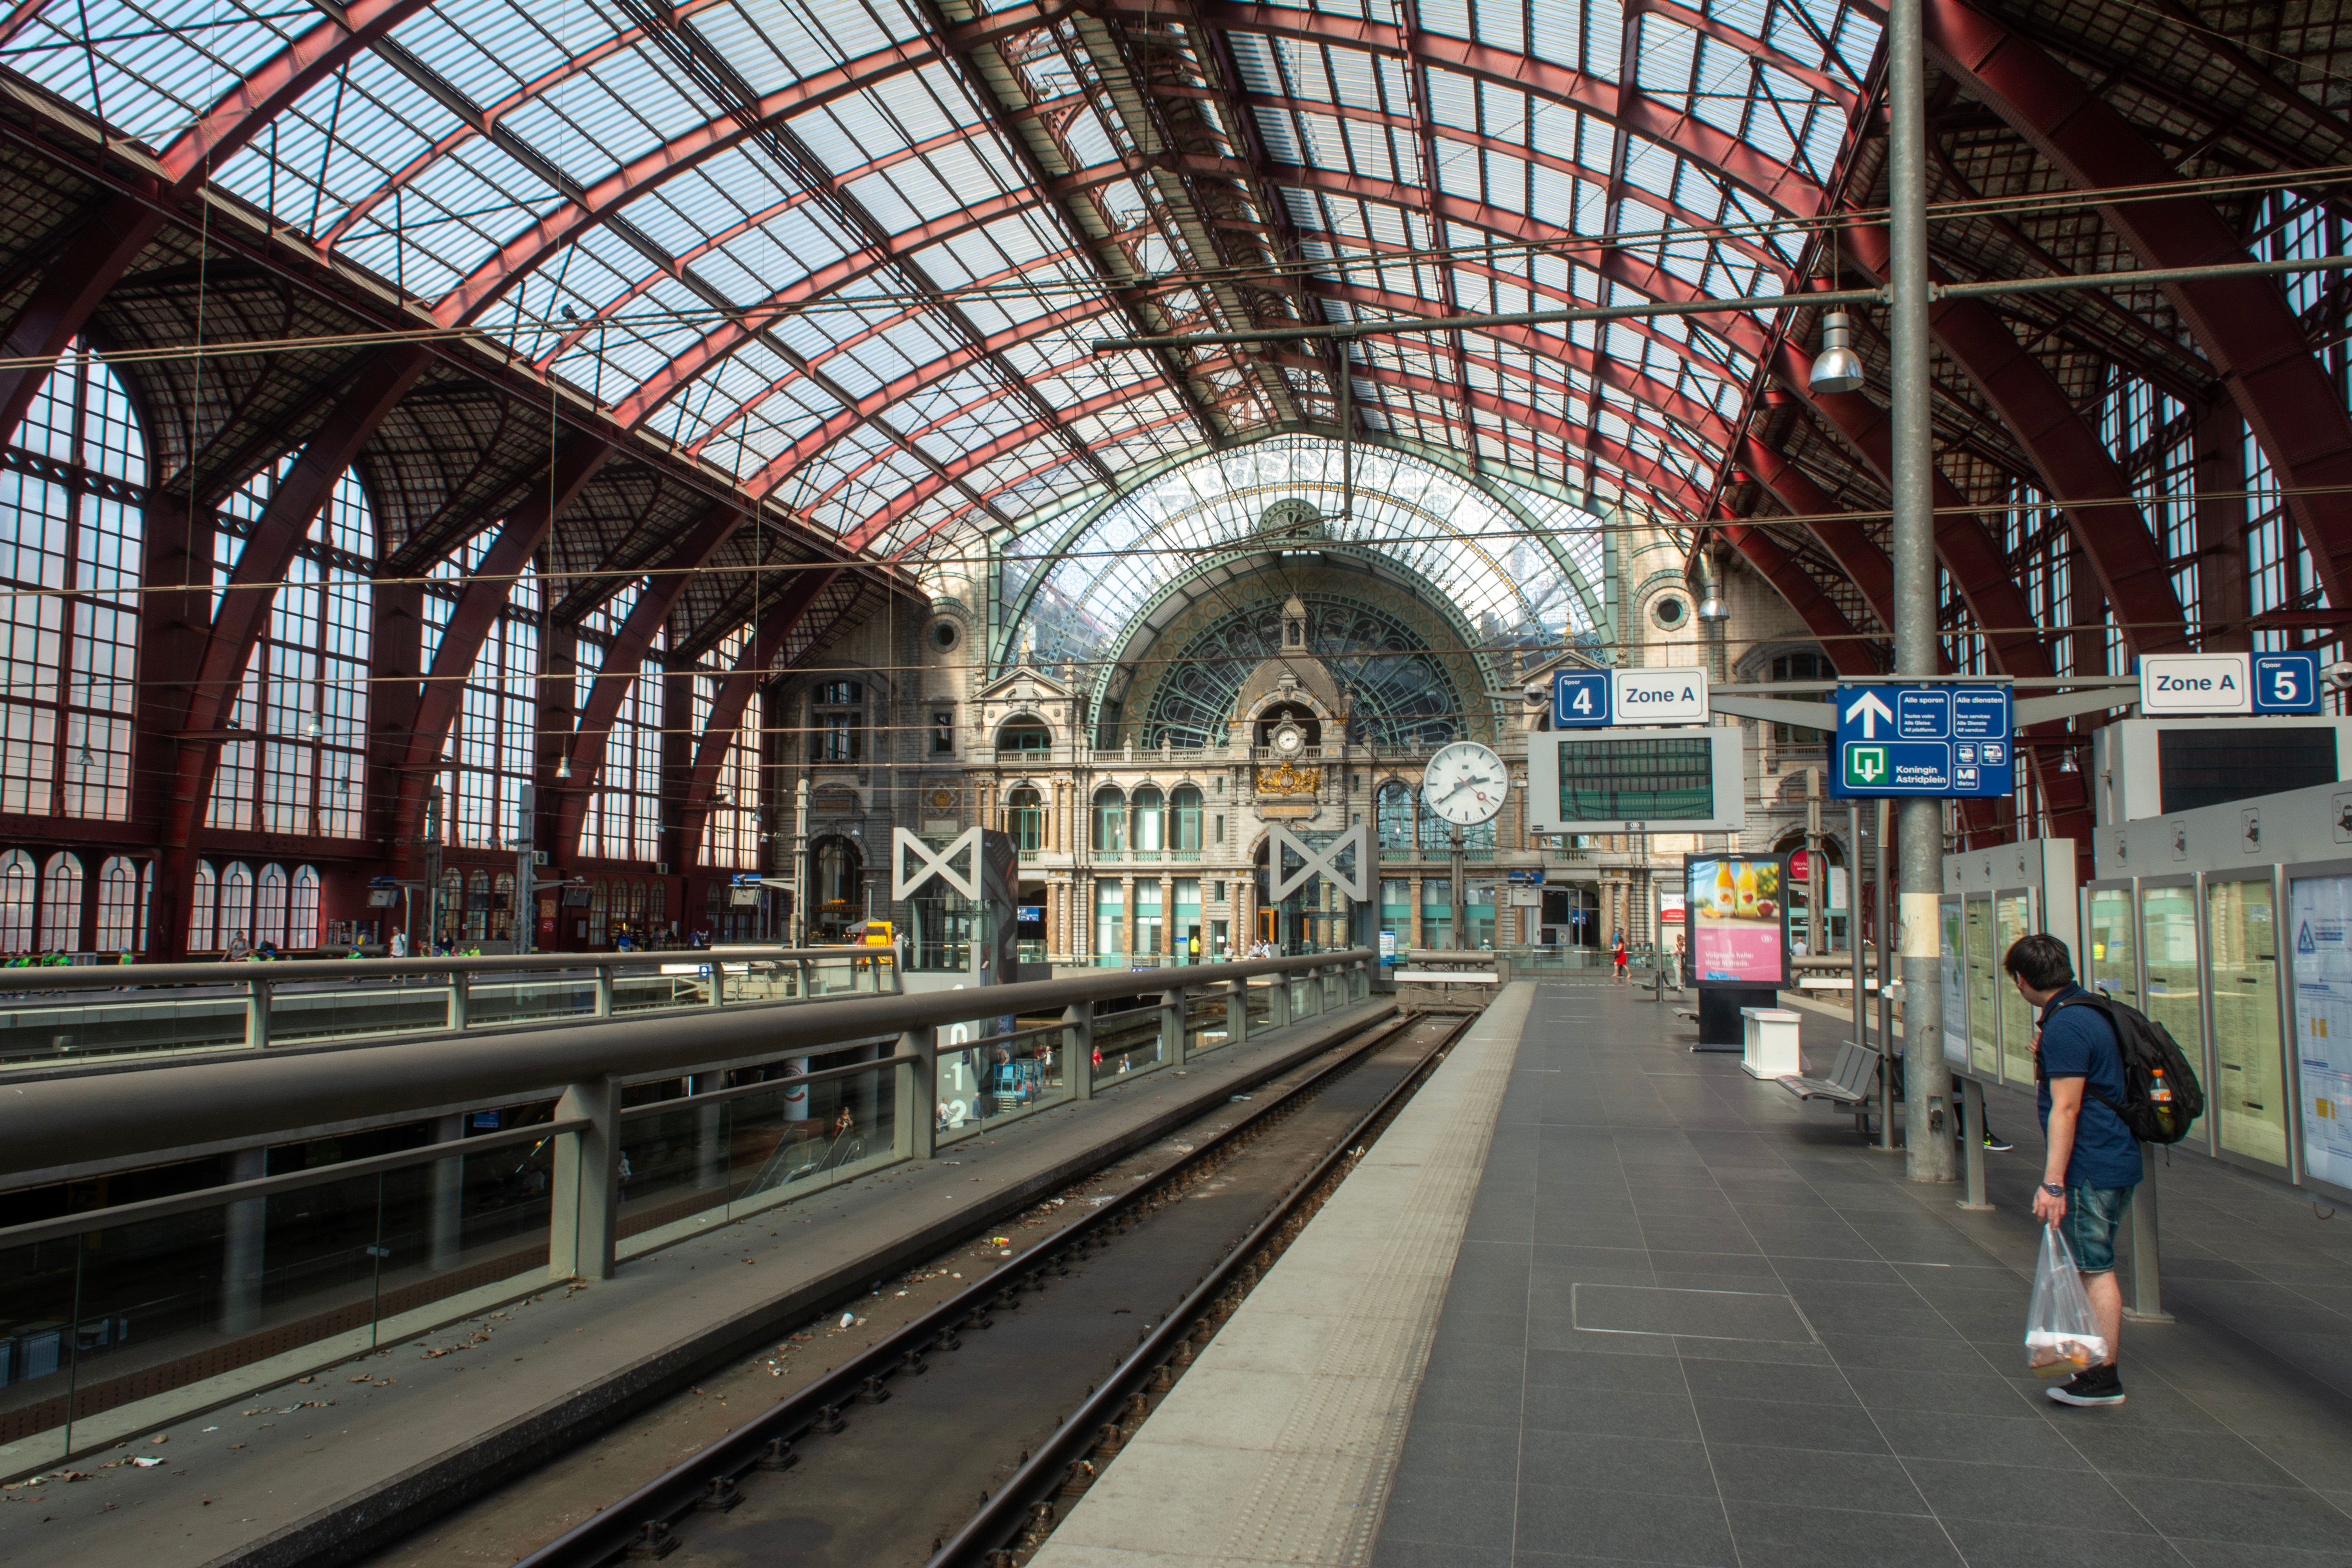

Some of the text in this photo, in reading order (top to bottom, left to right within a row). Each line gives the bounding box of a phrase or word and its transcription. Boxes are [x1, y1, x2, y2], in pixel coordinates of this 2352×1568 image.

[2156, 675, 2235, 691] Zone A
[2273, 671, 2297, 701] 5
[1572, 688, 1592, 715] 4
[1626, 687, 1695, 703] Zone A
[1896, 766, 1937, 775] Koningin
[1957, 769, 1976, 779] M
[1896, 775, 1947, 785] Astridplein
